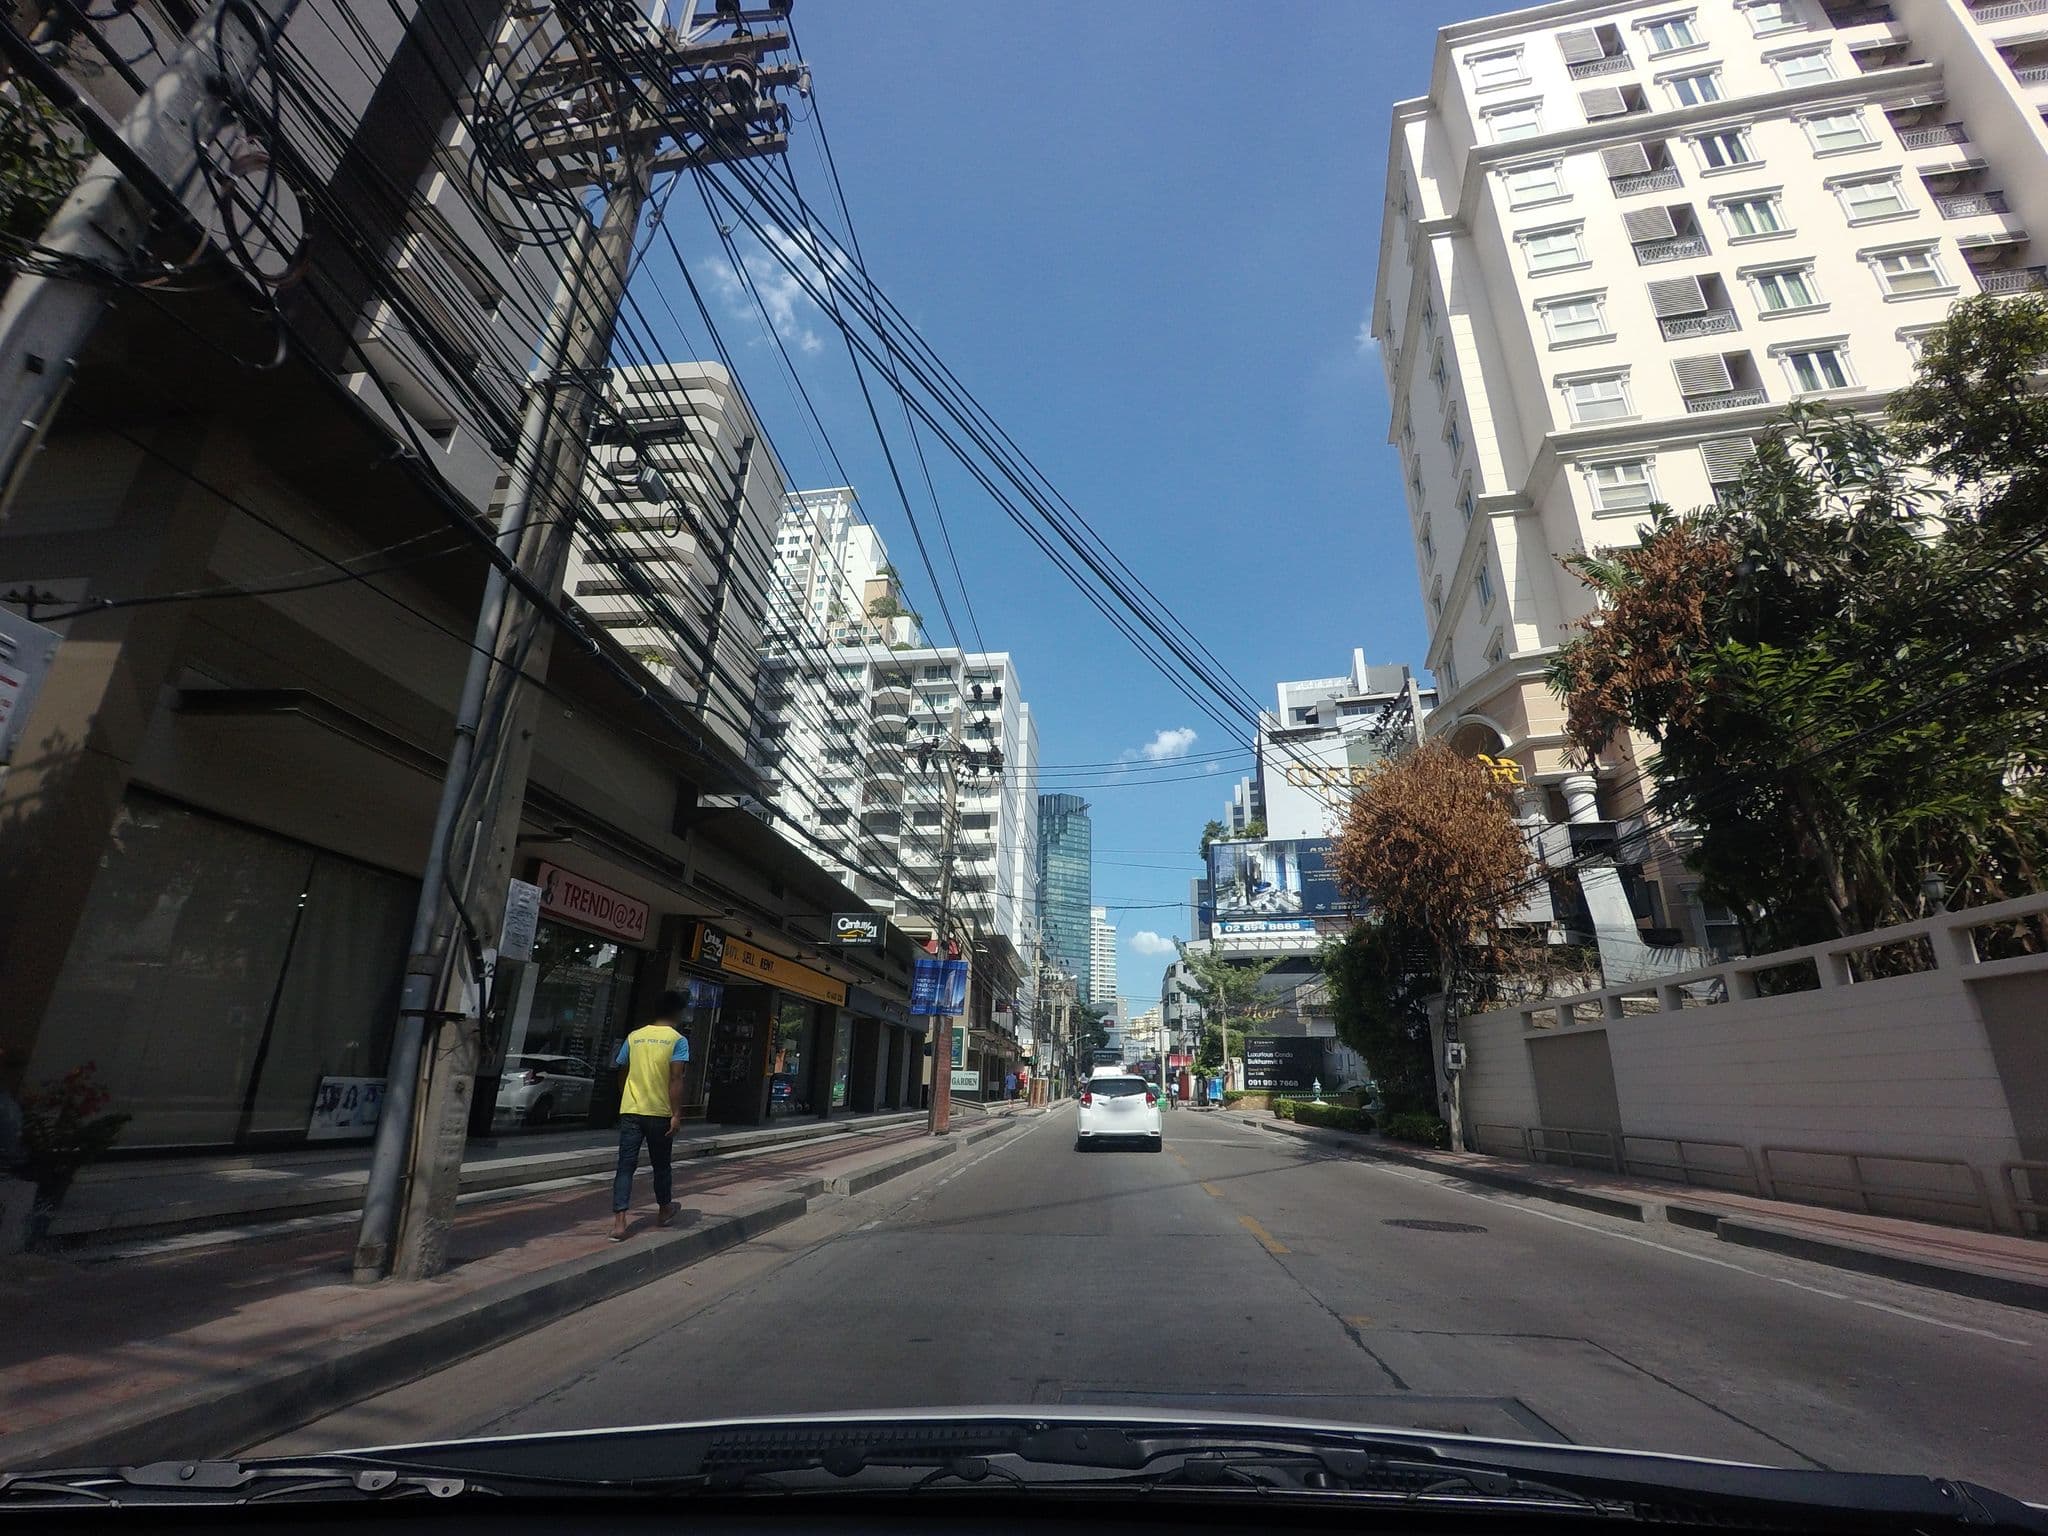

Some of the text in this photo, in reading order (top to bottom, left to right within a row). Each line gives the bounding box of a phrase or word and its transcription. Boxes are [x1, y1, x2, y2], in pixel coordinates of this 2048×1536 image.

[564, 882, 643, 931] TRENDI@24
[838, 918, 871, 930] Century
[866, 926, 877, 937] 21
[952, 1077, 977, 1086] GARDEN
